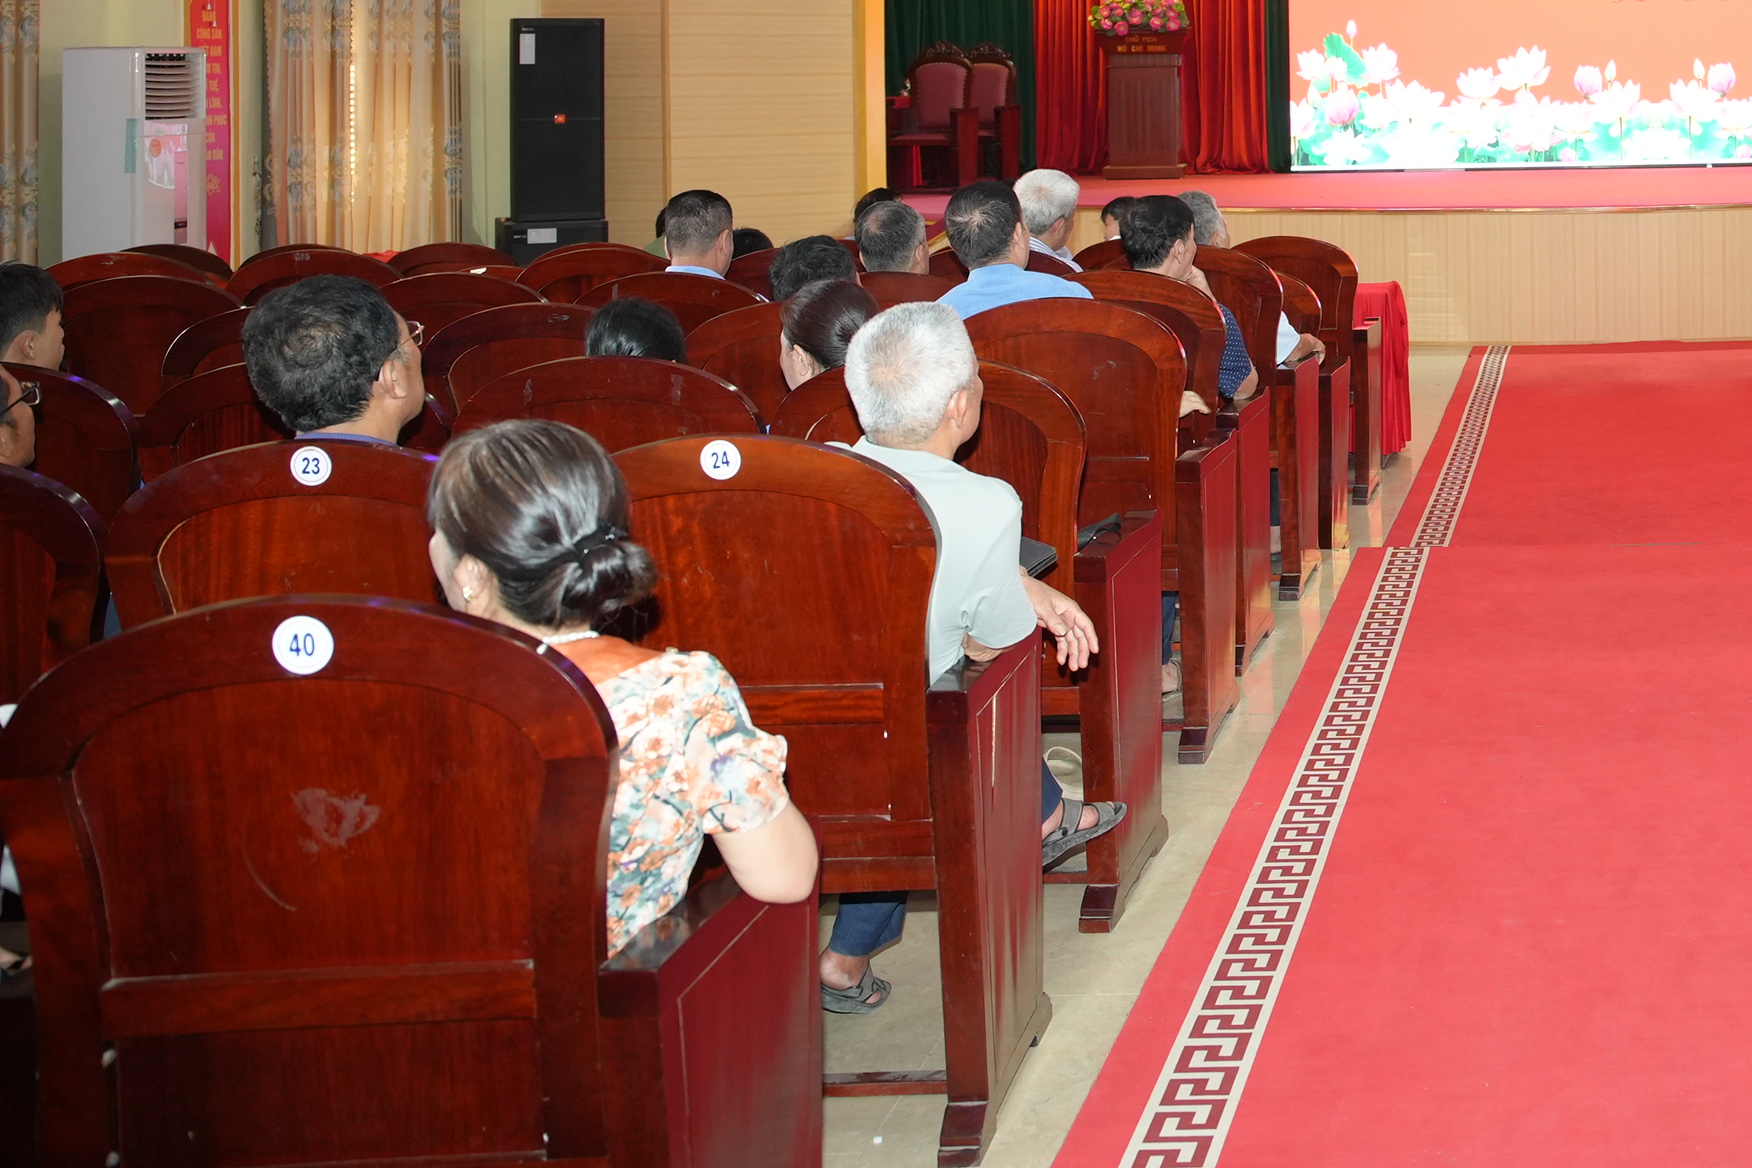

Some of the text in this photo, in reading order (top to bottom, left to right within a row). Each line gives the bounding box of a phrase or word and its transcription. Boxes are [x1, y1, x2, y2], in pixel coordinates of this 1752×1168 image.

[301, 457, 320, 475] 23
[711, 451, 730, 470] 24
[289, 633, 315, 657] 40
